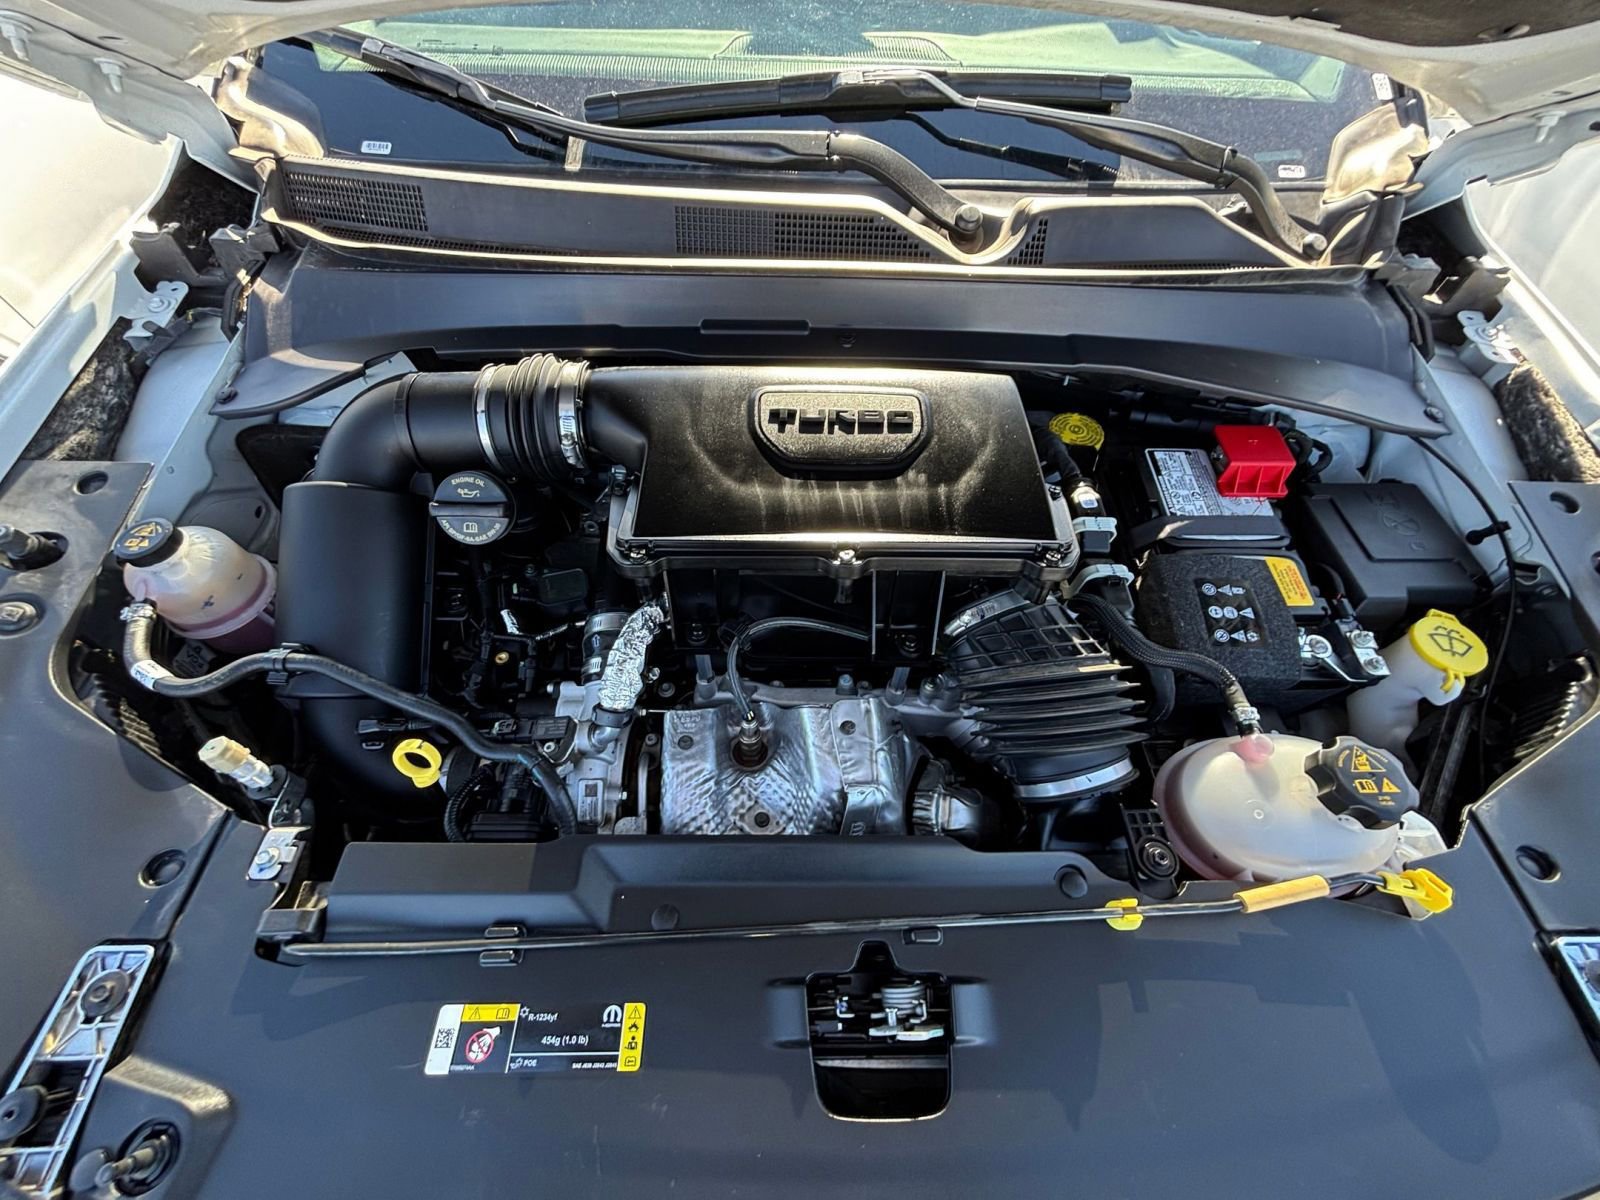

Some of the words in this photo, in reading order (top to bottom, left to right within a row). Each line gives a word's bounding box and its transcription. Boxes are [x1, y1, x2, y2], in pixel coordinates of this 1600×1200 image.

[768, 408, 914, 435] TURBO
[451, 476, 475, 485] ENGINE
[475, 478, 486, 487] OIL
[528, 1012, 558, 1023] R-1234yf
[541, 1035, 561, 1046] 454g
[562, 1035, 577, 1046] (1.0
[577, 1035, 589, 1046] lb)
